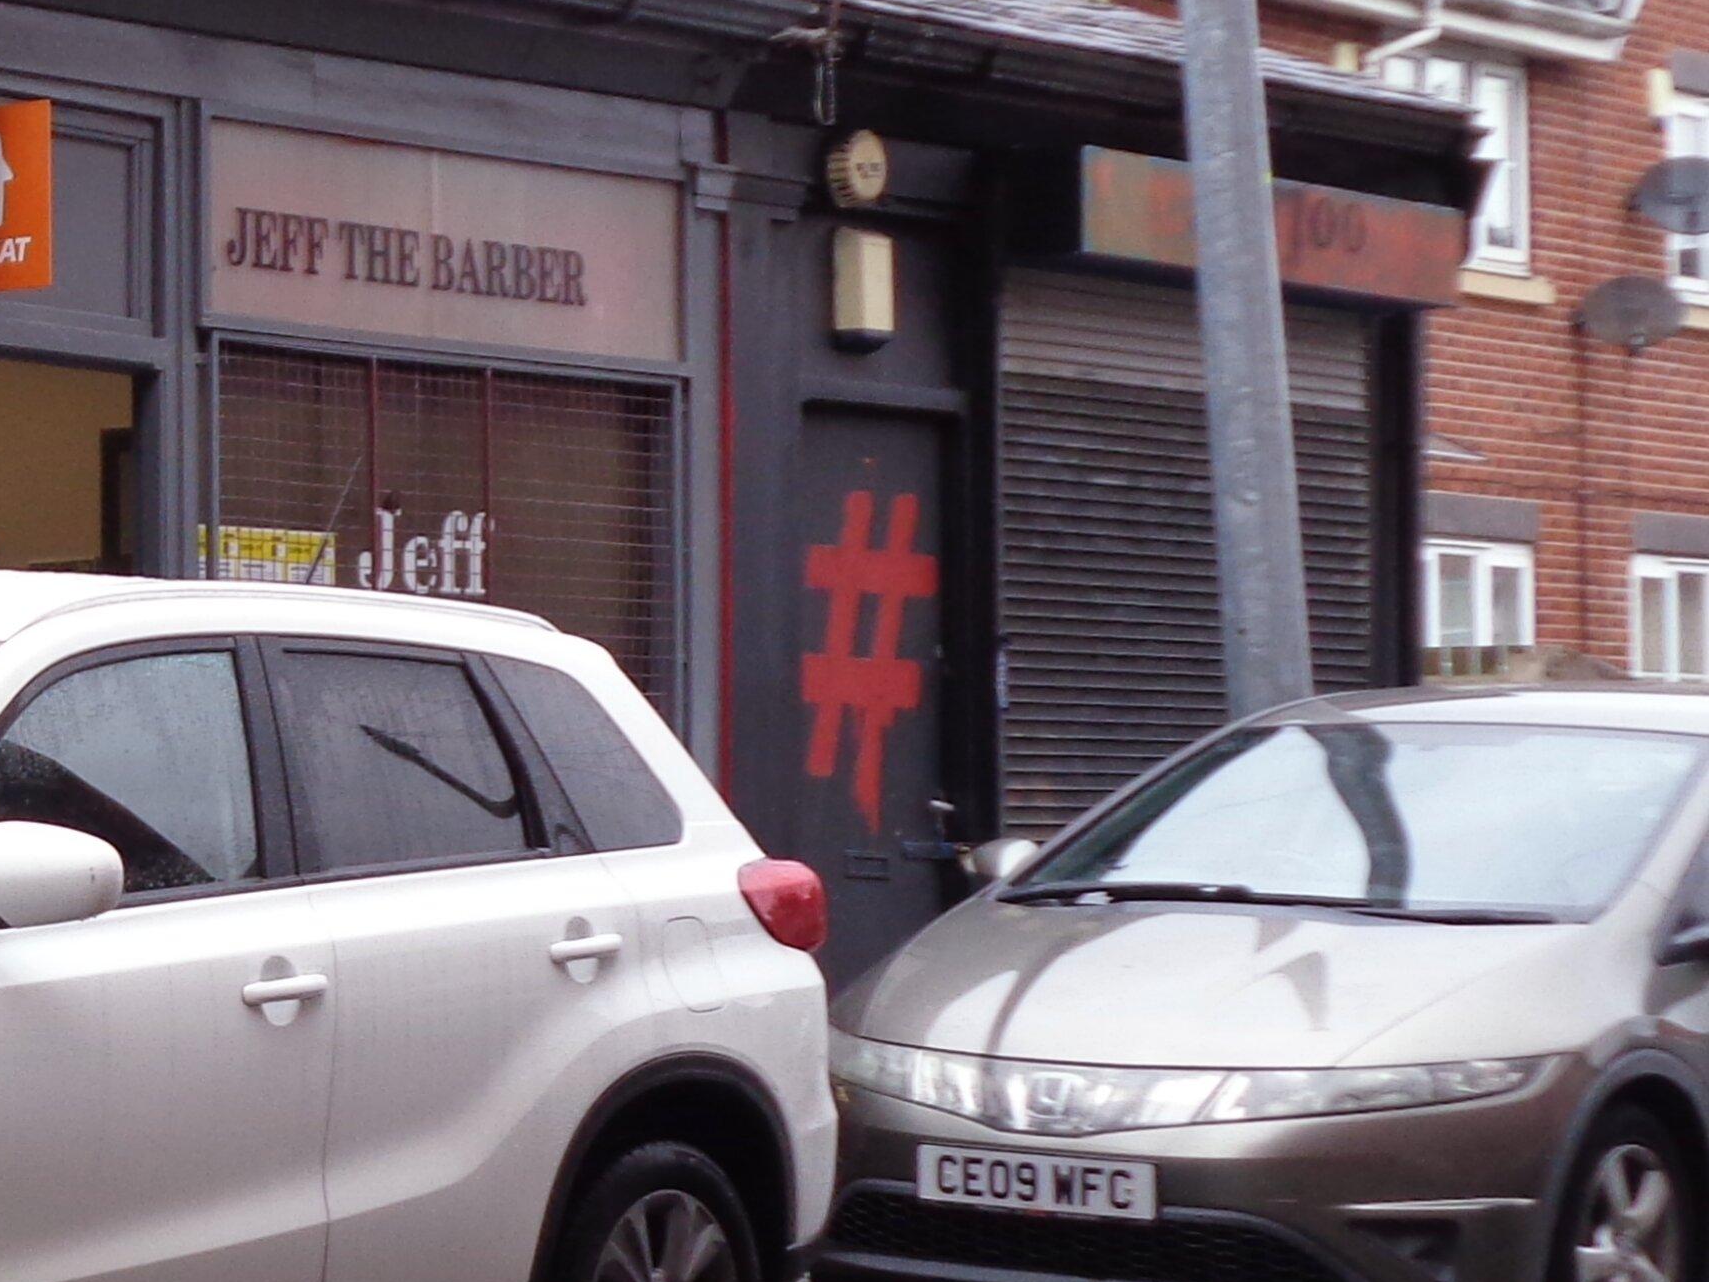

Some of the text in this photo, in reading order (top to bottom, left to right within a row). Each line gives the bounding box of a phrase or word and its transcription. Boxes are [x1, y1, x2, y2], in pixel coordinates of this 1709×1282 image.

[226, 206, 587, 307] JEFF THE BARBER
[358, 508, 488, 596] Jeff
[936, 1154, 1135, 1210] CE09 WFG
